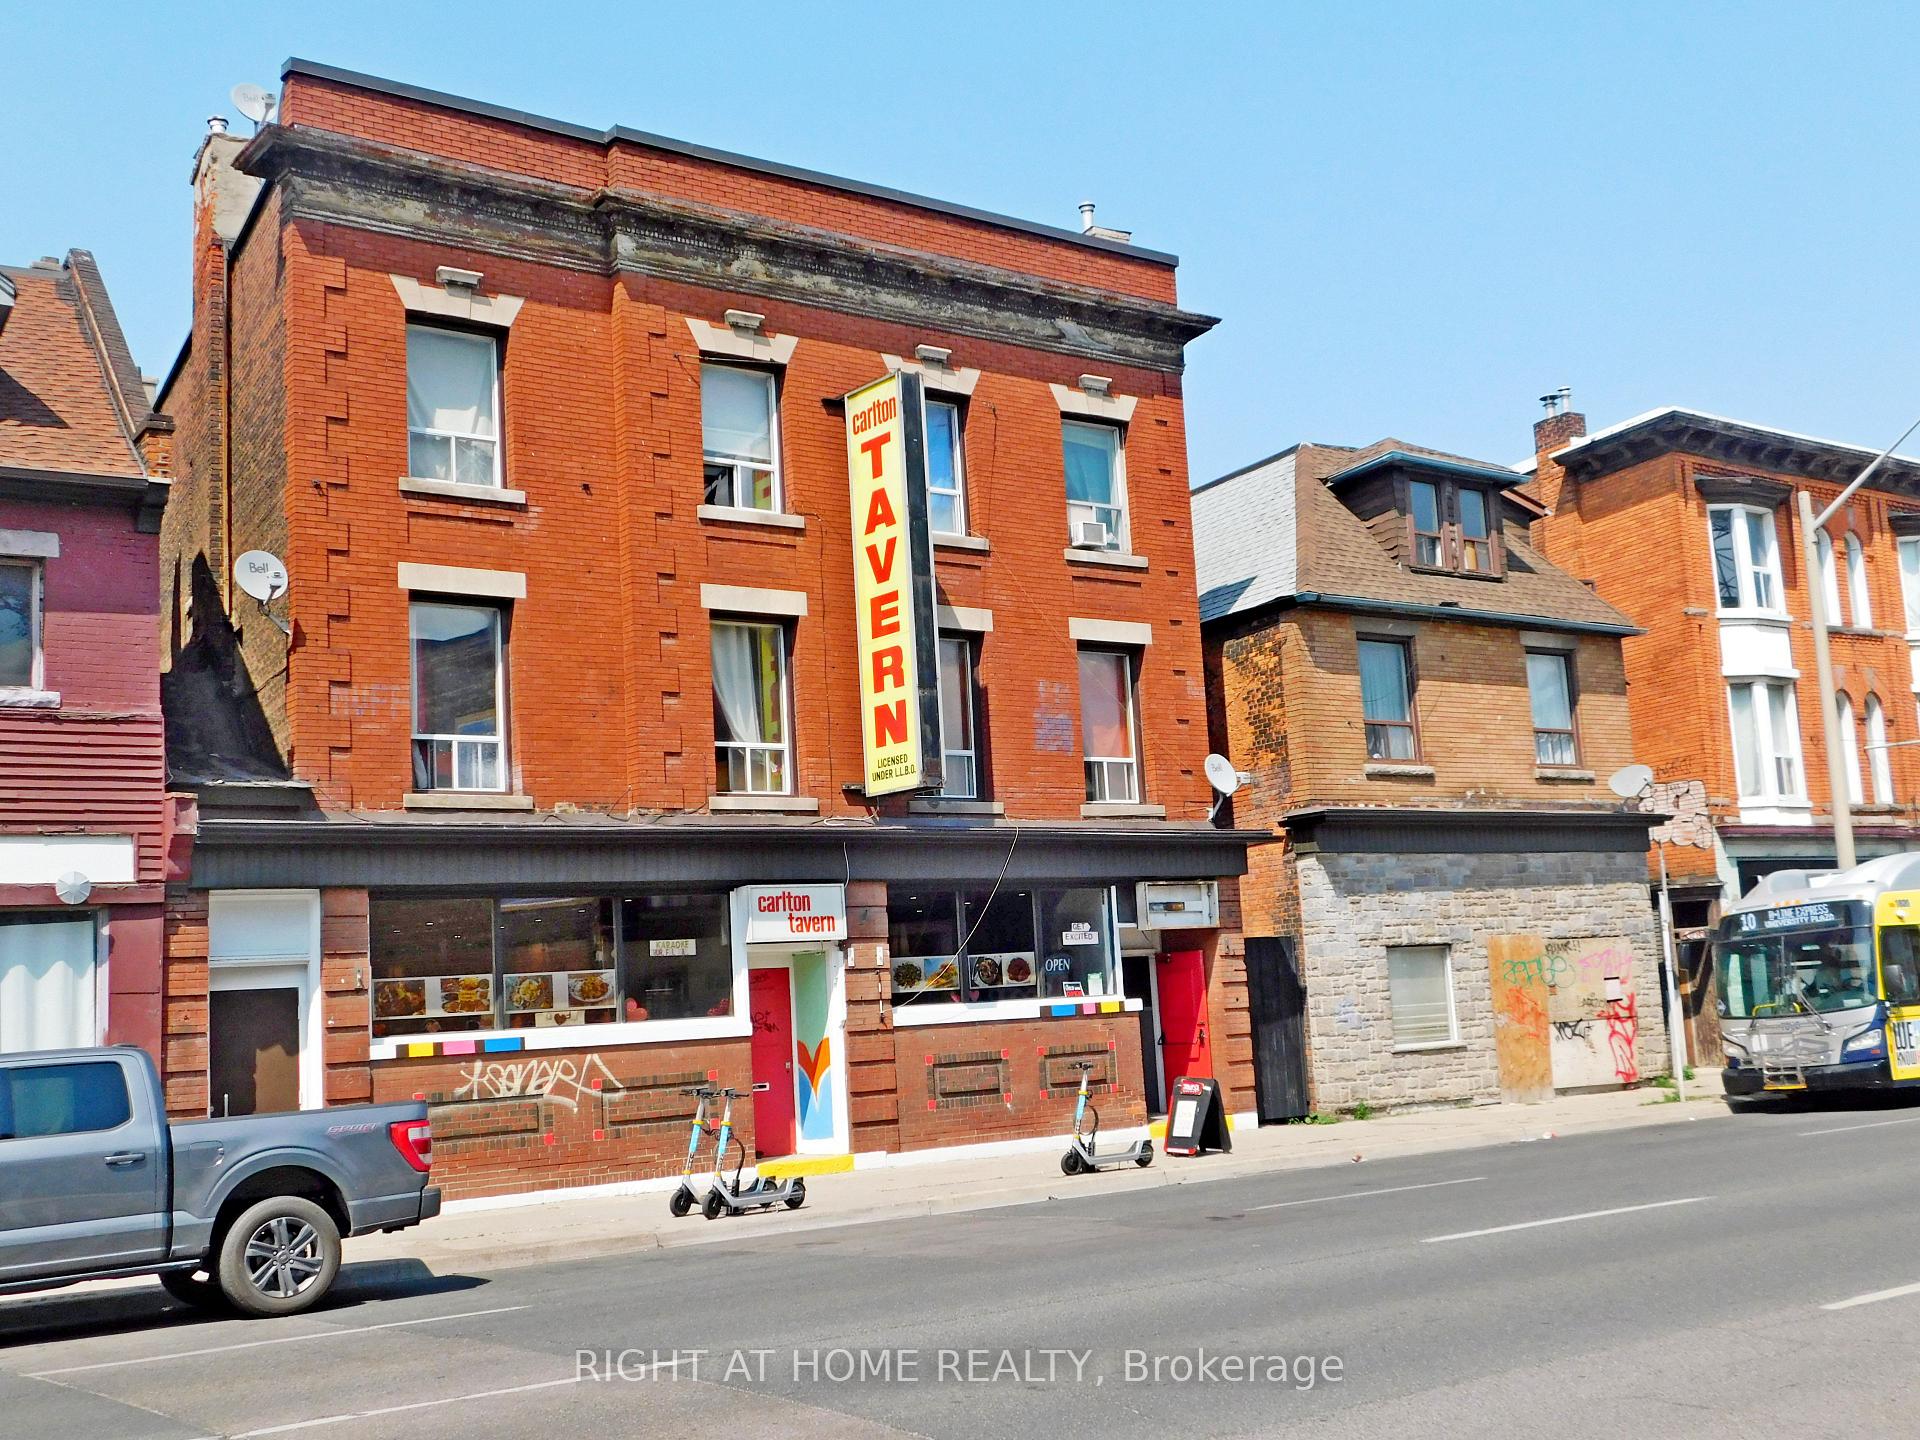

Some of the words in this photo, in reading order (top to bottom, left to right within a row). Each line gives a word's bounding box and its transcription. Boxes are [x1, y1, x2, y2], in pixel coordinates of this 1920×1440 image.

[852, 396, 897, 435] carlton
[249, 561, 269, 574] Bell
[860, 431, 908, 748] TAVERN
[877, 753, 908, 769] LICENSED
[871, 769, 894, 782] UNDER
[757, 891, 812, 913] carlton
[788, 912, 836, 933] tavern
[1741, 912, 1757, 931] 10
[1796, 903, 1829, 918] EXPRESS
[1764, 916, 1809, 929] UNIVERSITY
[1810, 913, 1835, 923] PLAZA
[1072, 923, 1087, 931] GET
[656, 940, 689, 949] KARAOKE
[1065, 932, 1094, 941] EXCITED
[1045, 958, 1071, 972] OPEN
